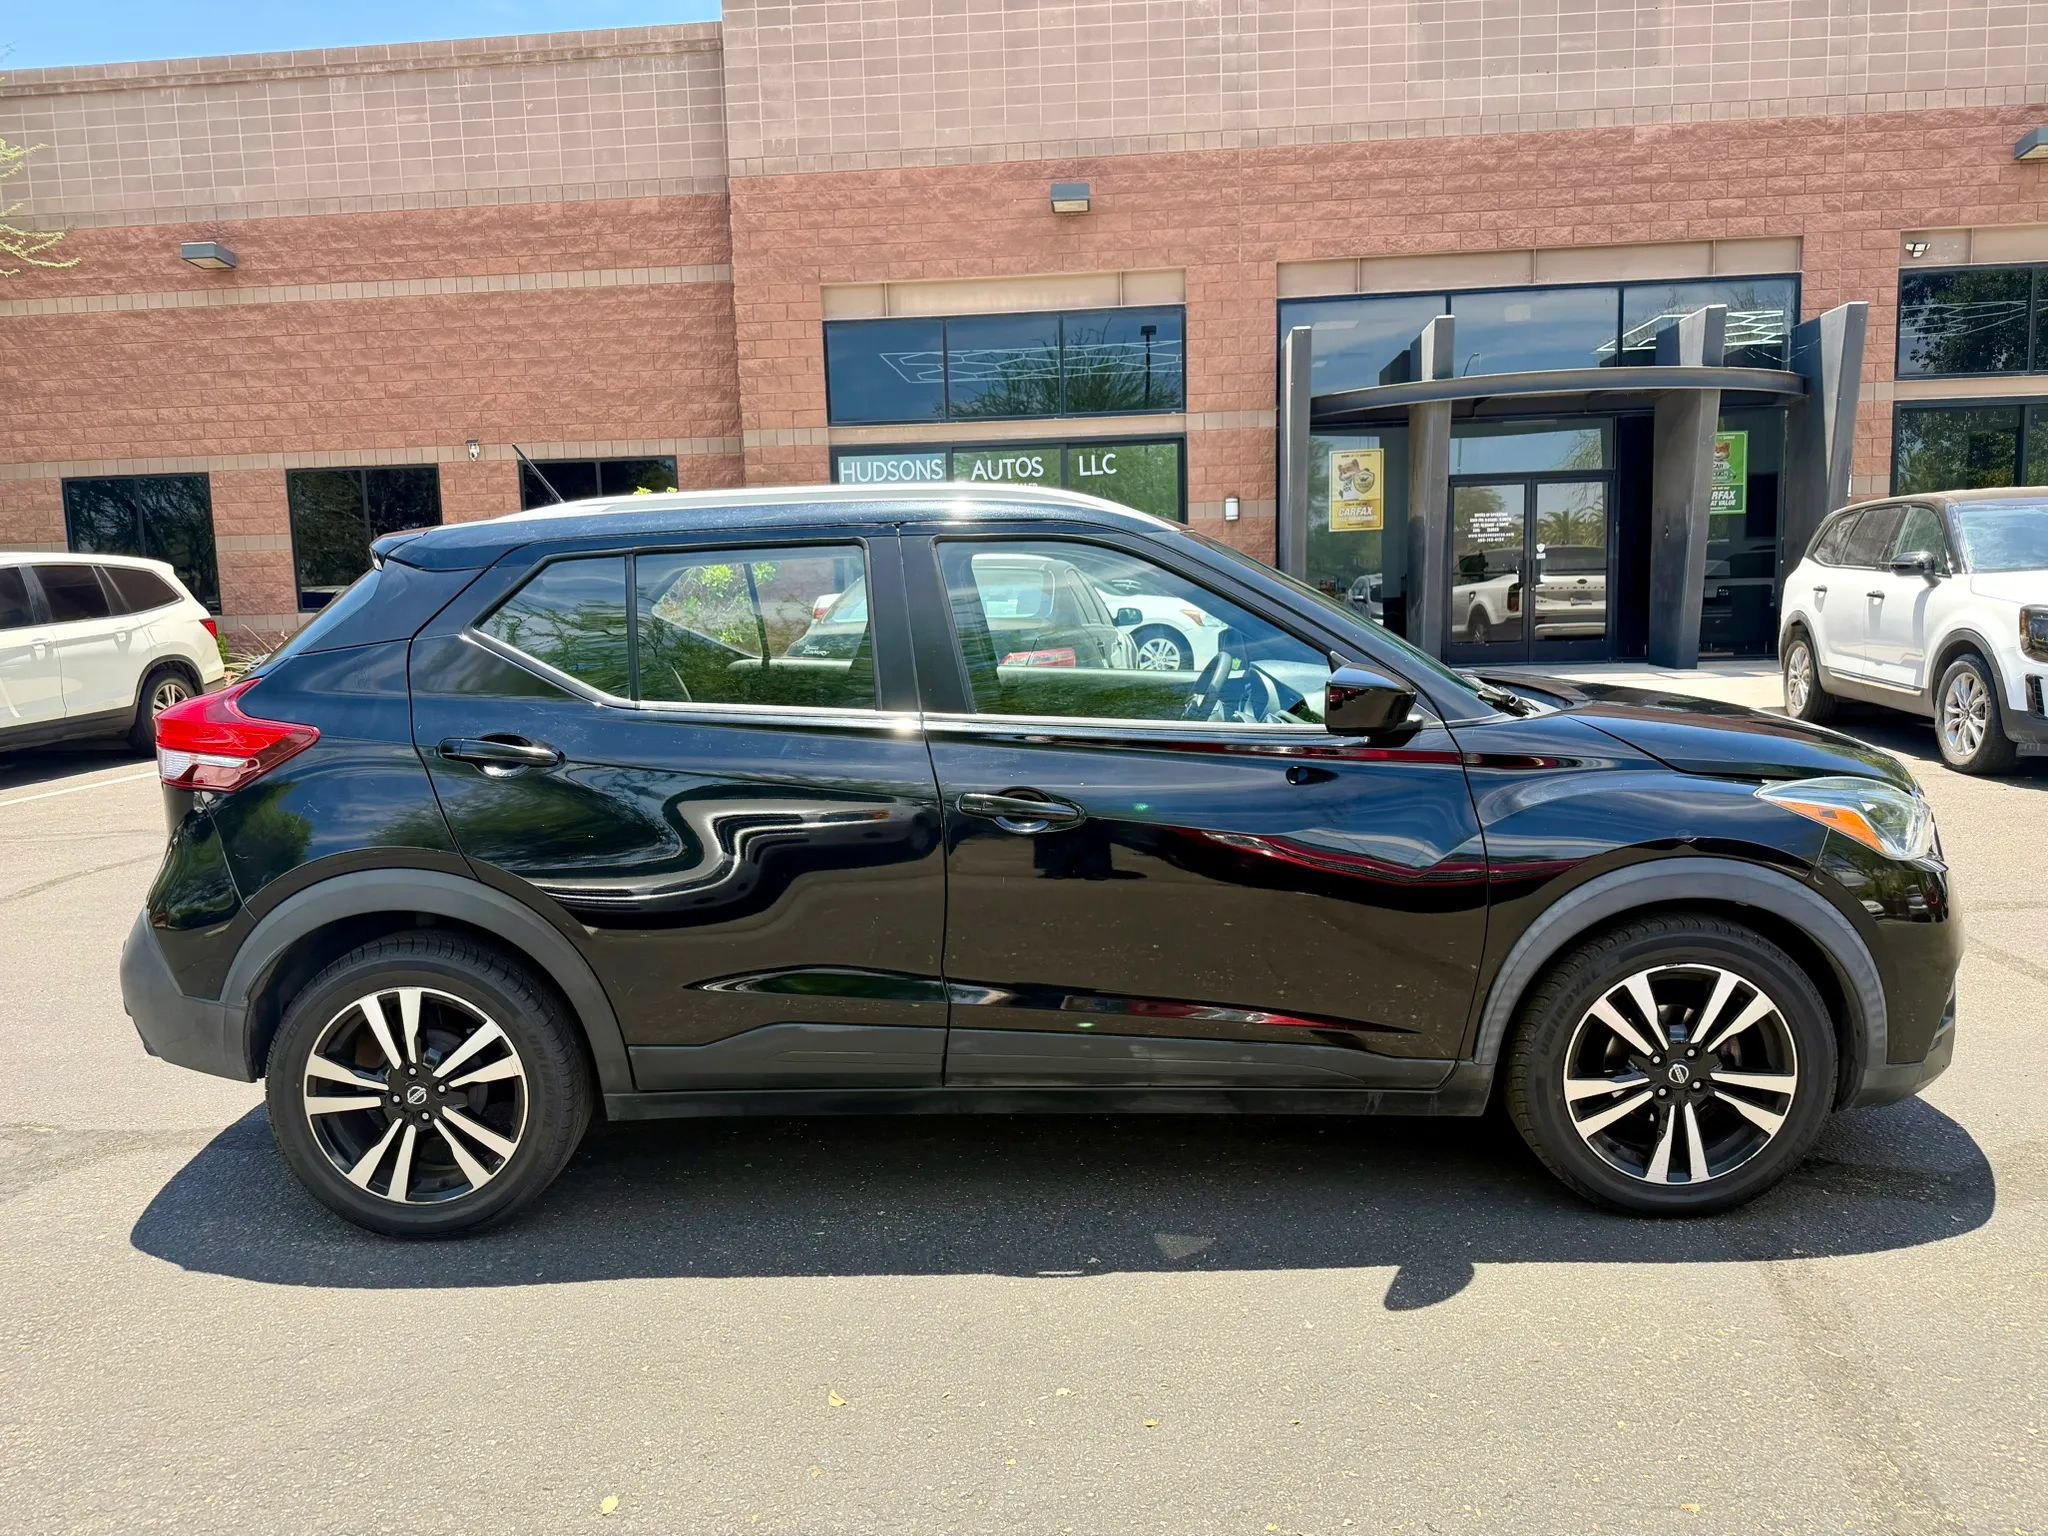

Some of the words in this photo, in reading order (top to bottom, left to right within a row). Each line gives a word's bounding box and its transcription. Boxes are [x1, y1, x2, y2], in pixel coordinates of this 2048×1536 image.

[839, 458, 944, 483] HUDSONS
[970, 456, 1044, 482] AUTOS
[1078, 453, 1118, 477] LLC
[1711, 490, 1736, 500] RFAX
[1339, 506, 1373, 516] CARFAX
